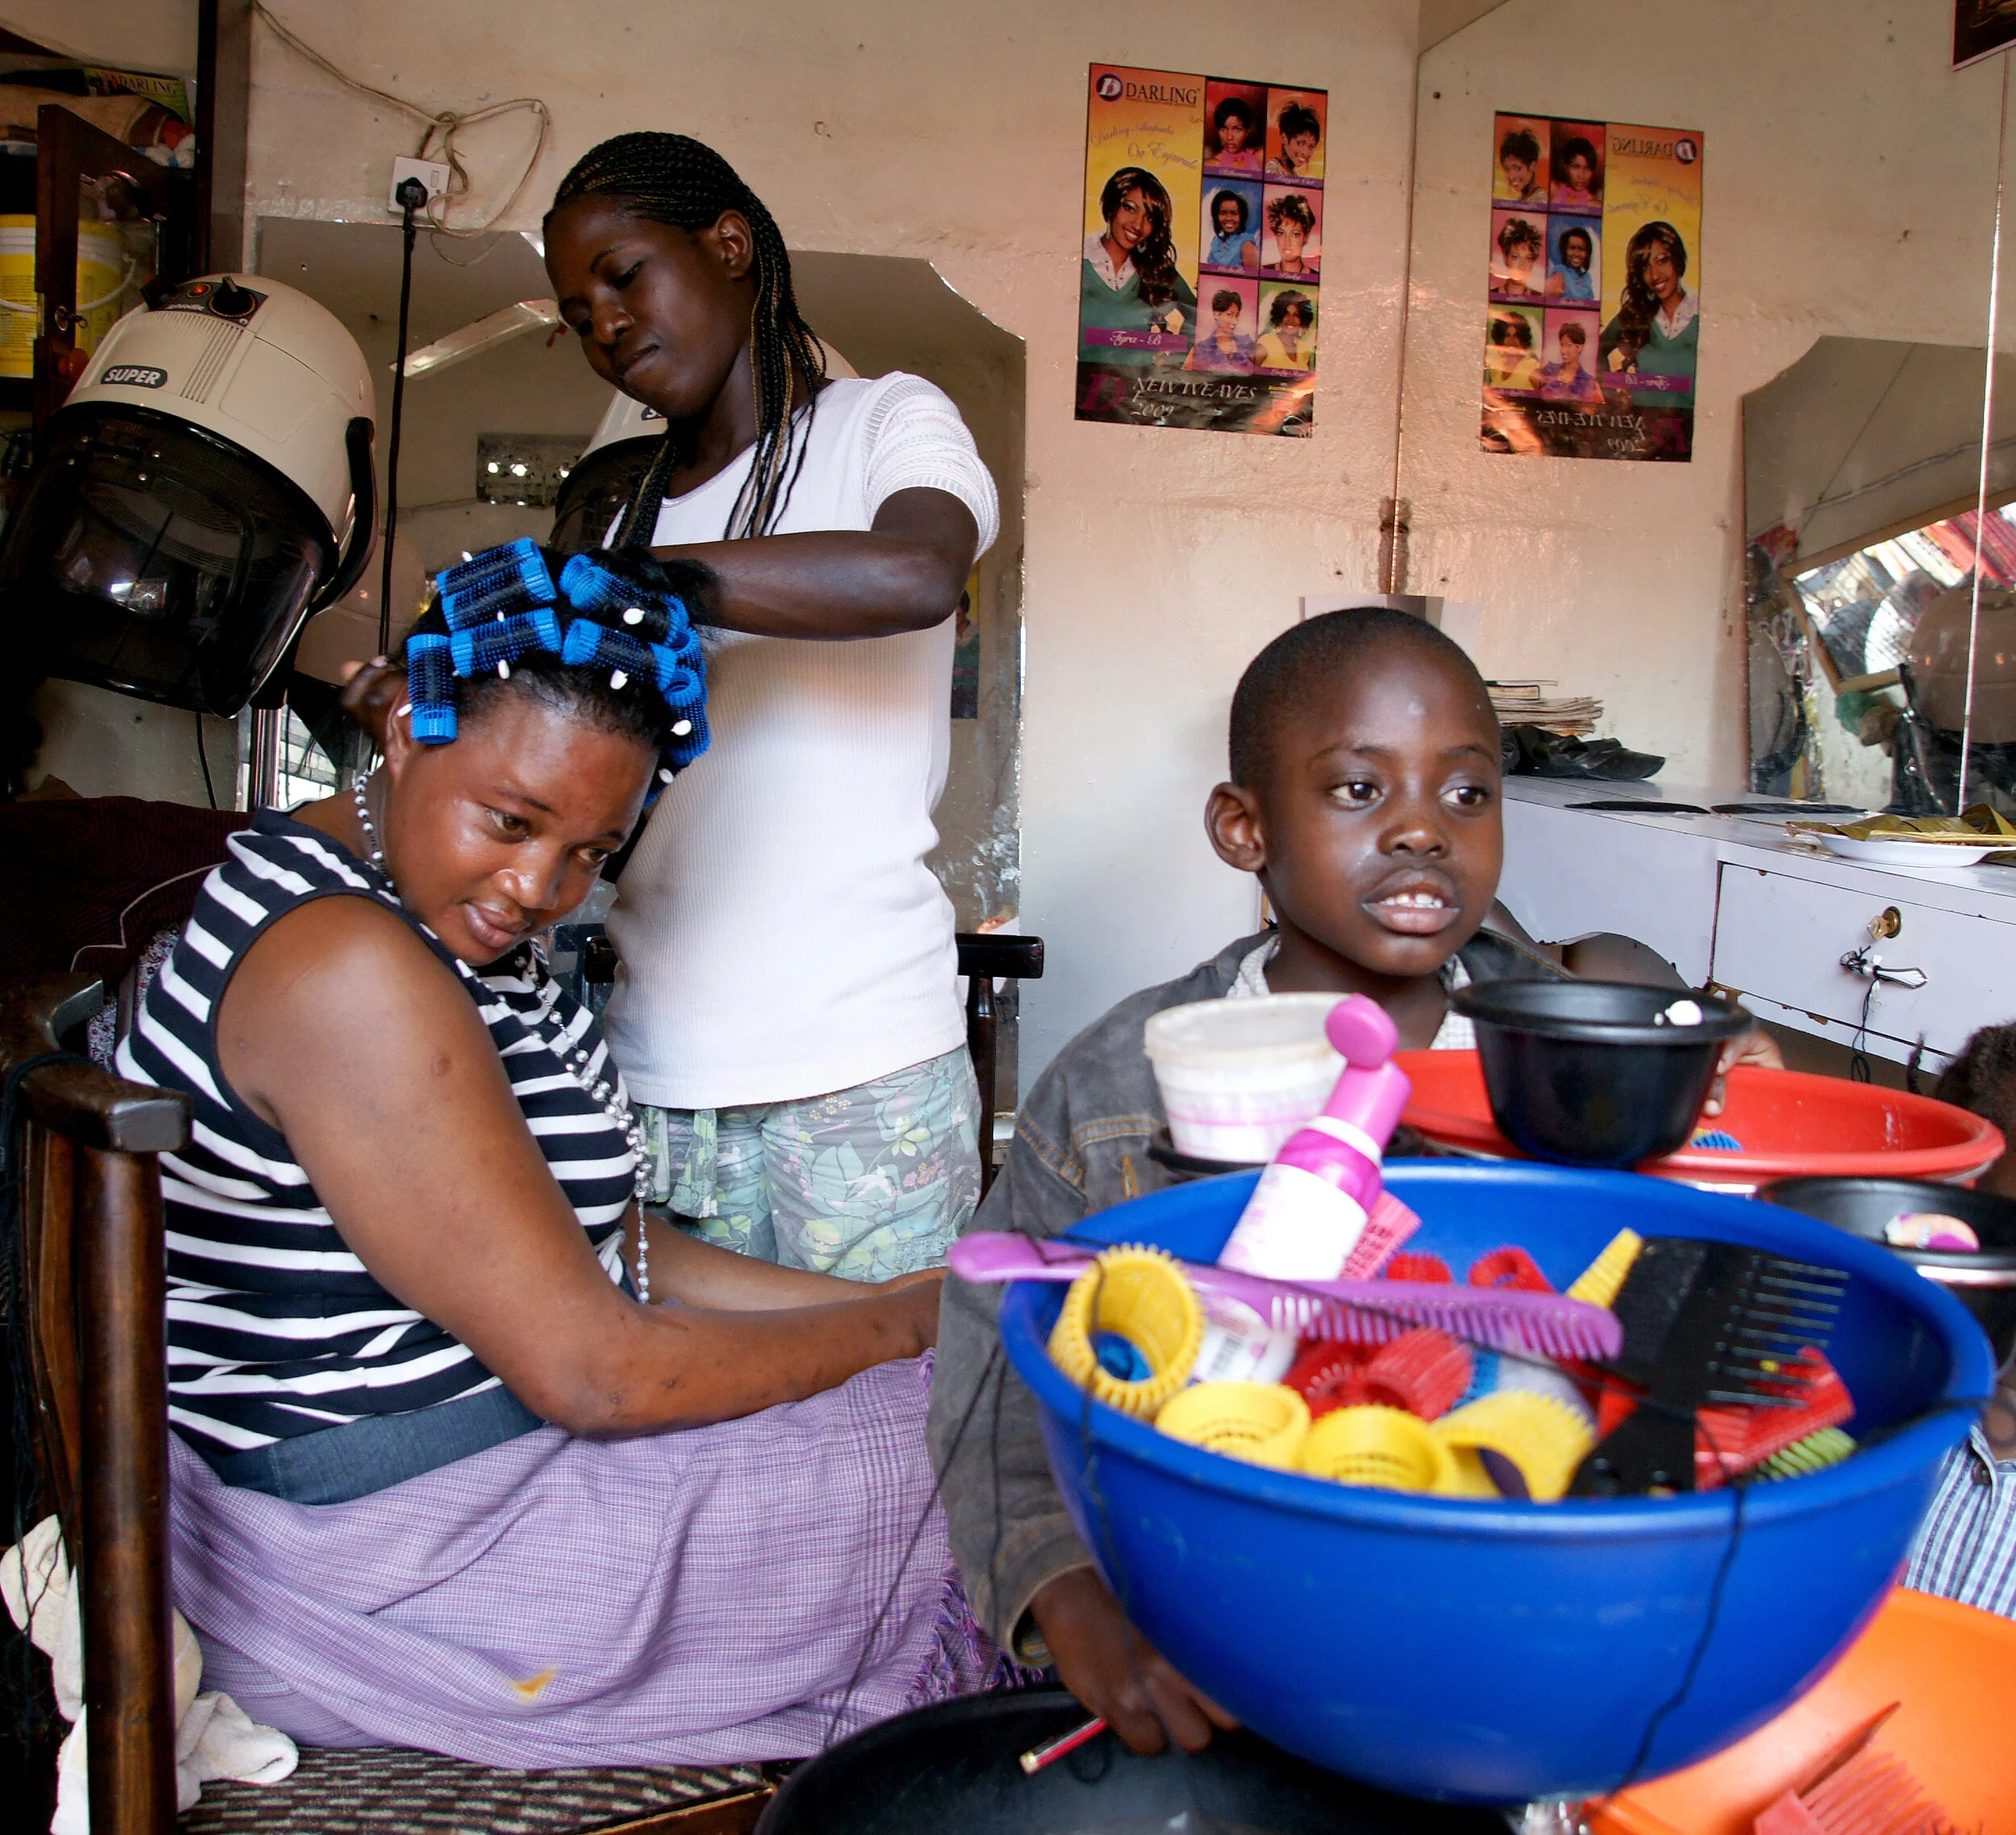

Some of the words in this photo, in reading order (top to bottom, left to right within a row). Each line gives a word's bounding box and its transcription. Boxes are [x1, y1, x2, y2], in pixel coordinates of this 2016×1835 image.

[118, 74, 177, 95] DARLING
[1126, 81, 1198, 105] DARLING
[105, 368, 161, 386] SUPER
[1180, 380, 1258, 399] WEAVES
